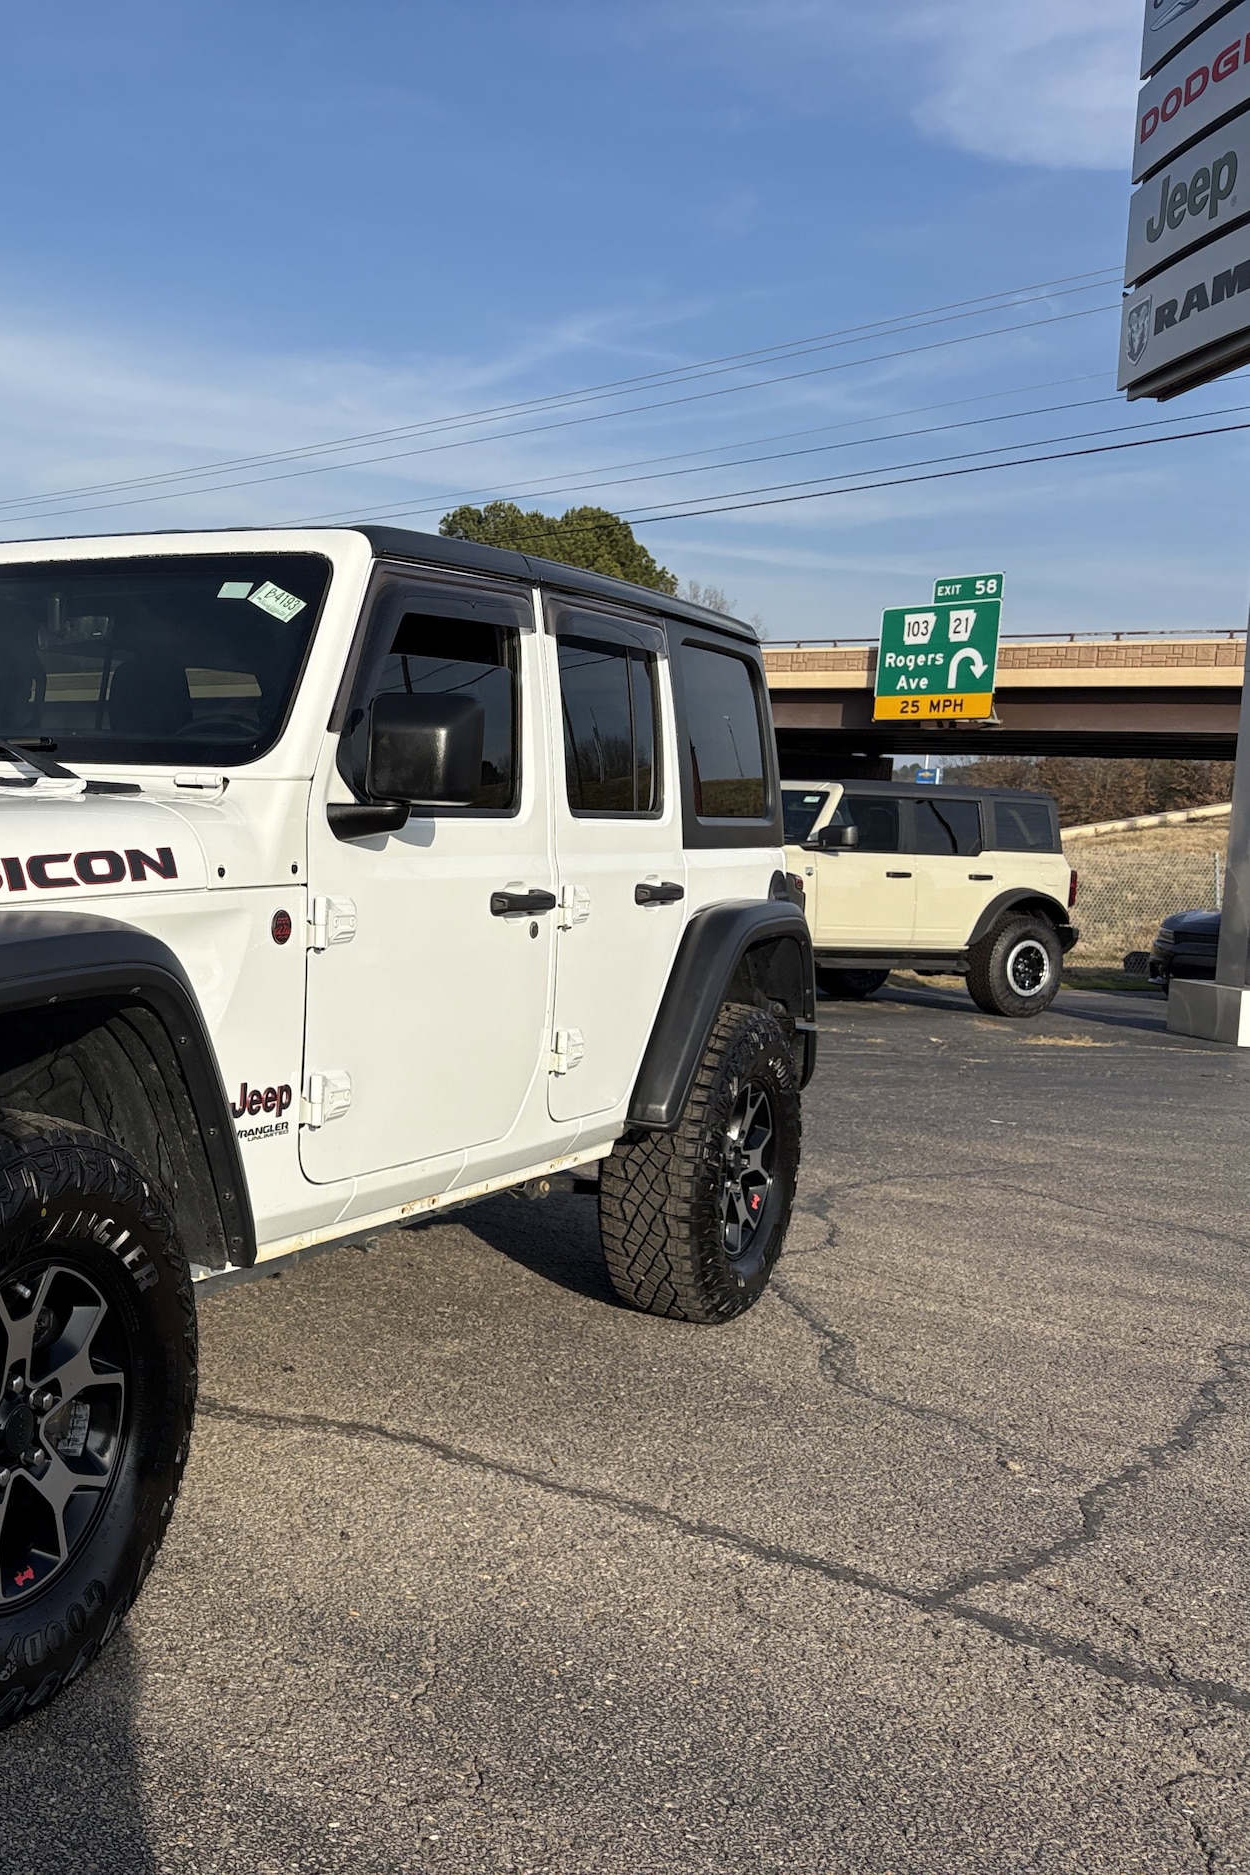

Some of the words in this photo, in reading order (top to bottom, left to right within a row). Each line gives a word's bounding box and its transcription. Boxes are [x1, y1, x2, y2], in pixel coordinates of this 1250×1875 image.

[1146, 150, 1238, 243] Jeep
[1153, 259, 1250, 336] RAM
[937, 584, 962, 596] EXIT
[974, 579, 997, 595] 58
[264, 587, 301, 611] B4193
[907, 620, 929, 637] 103
[953, 617, 969, 634] 21
[885, 652, 944, 671] Rogers
[895, 675, 929, 690] Ave
[900, 700, 920, 714] 25
[929, 699, 964, 713] MPH
[229, 1082, 292, 1119] Jeep
